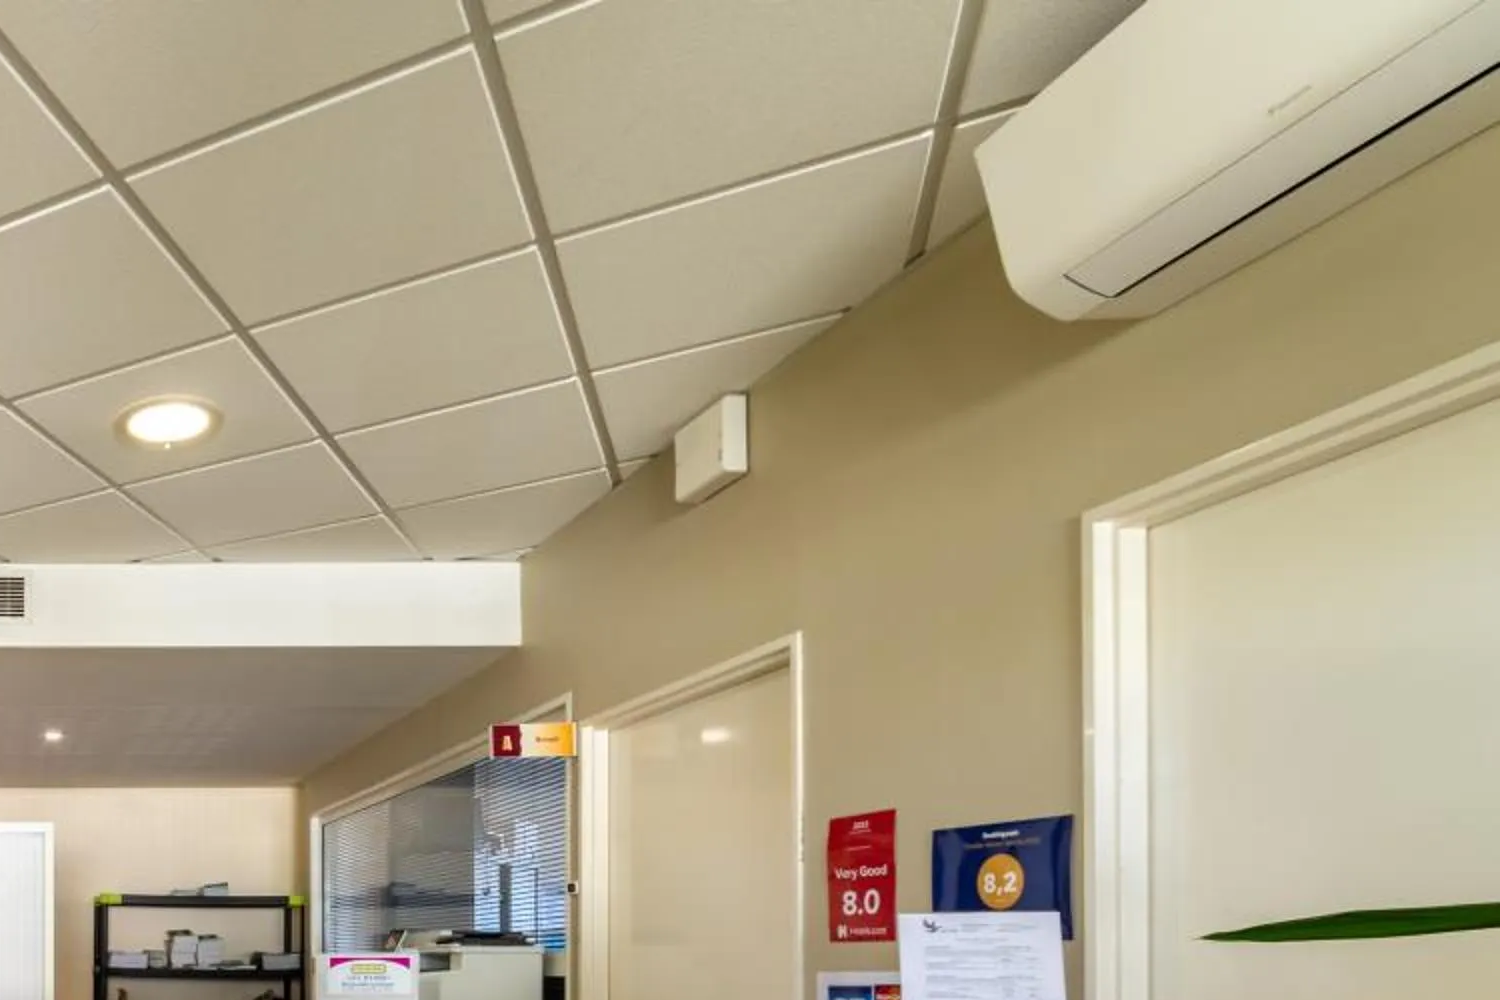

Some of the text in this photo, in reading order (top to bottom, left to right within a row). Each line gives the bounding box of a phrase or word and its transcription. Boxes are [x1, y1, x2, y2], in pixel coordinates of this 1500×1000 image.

[835, 864, 889, 881] Very Good
[983, 871, 1018, 896] 8,2
[842, 888, 881, 916] 8.0
